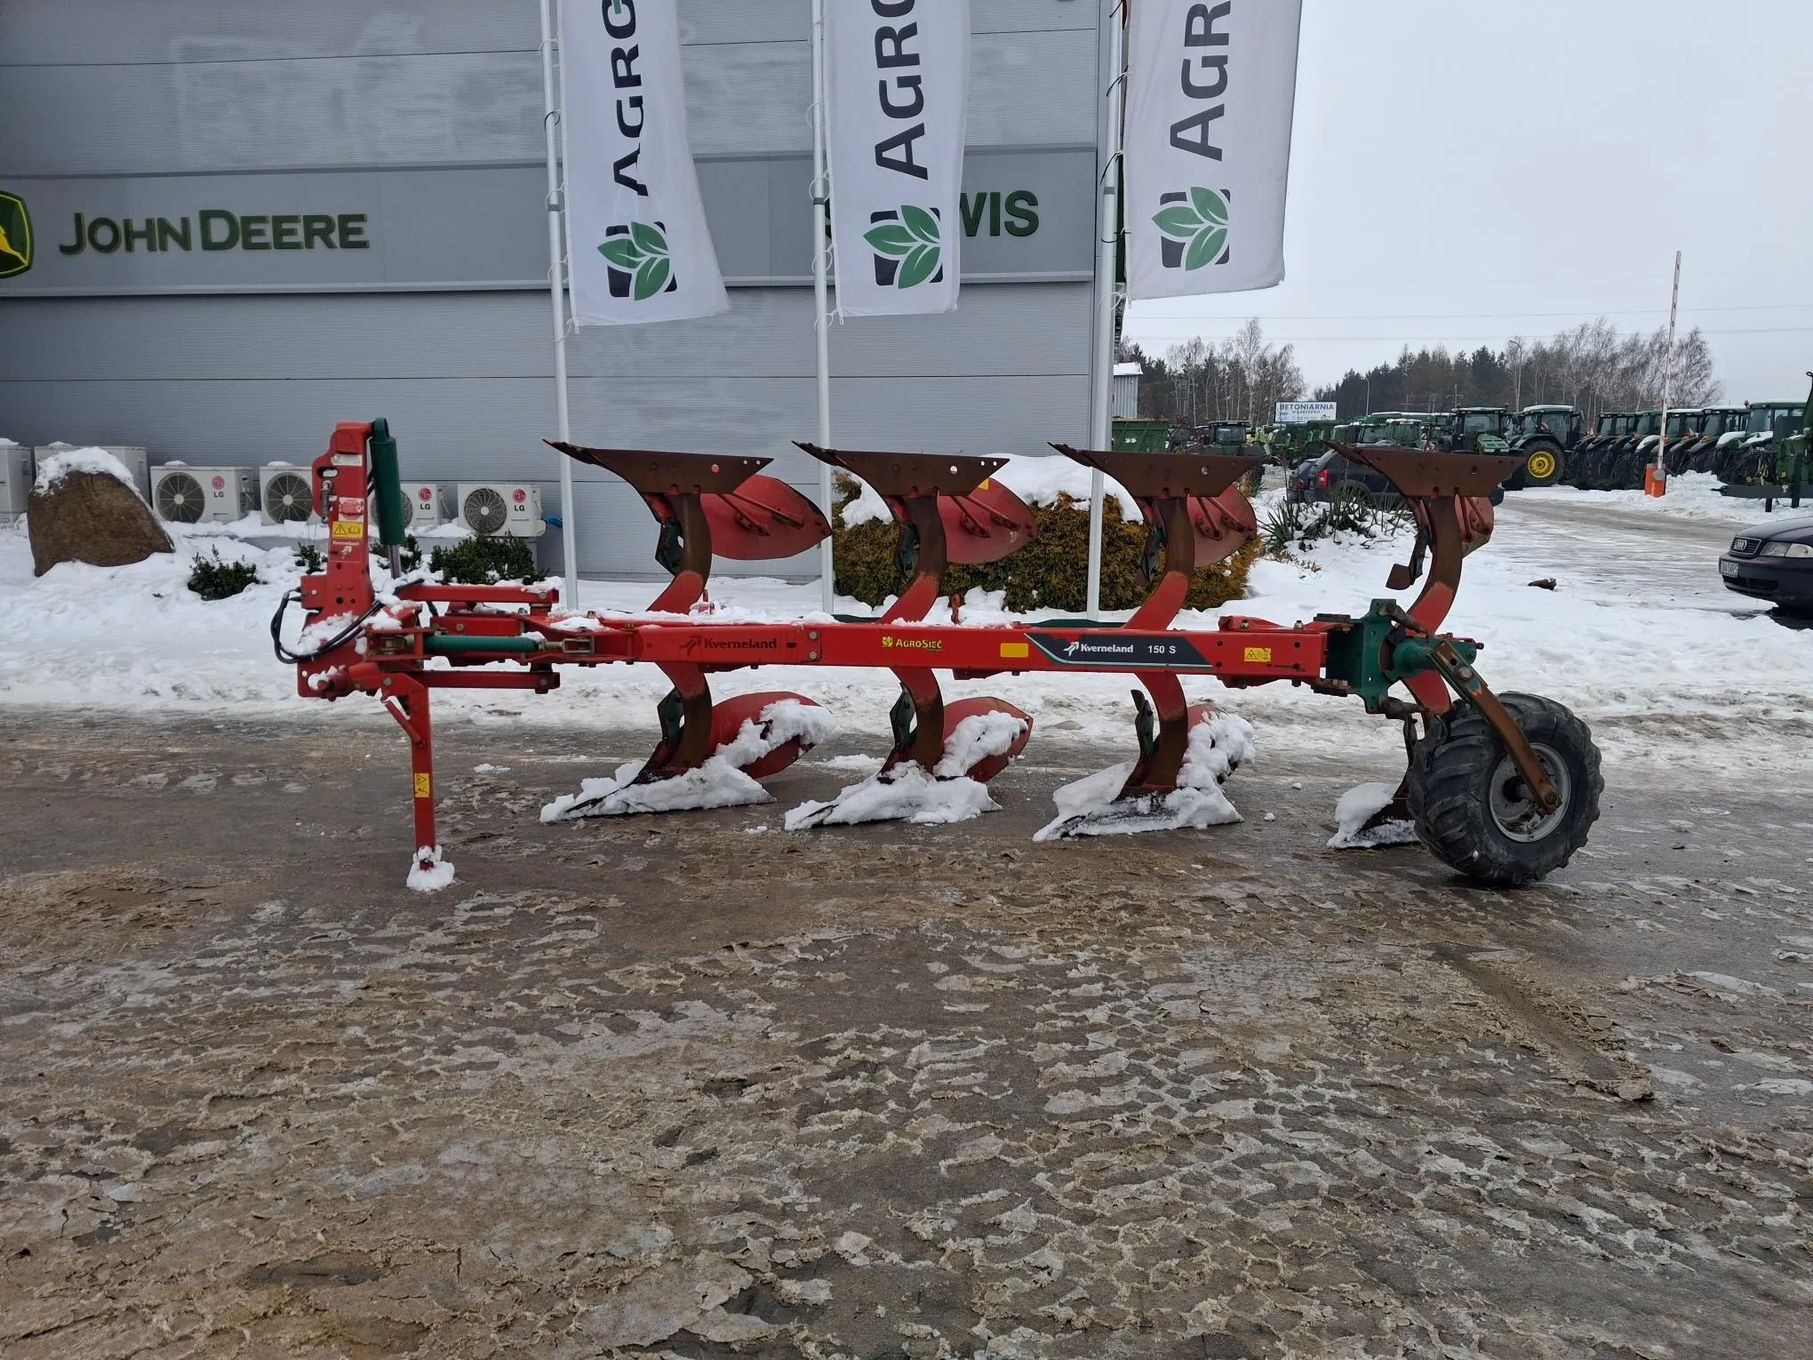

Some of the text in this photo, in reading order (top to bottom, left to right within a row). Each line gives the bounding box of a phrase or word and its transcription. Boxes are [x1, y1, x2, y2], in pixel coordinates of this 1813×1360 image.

[59, 209, 369, 255] JOHN DEERE
[1279, 403, 1335, 411] BETONIARNIA
[704, 638, 777, 649] Kverneland
[1081, 643, 1176, 654] Kverneland 150 S
